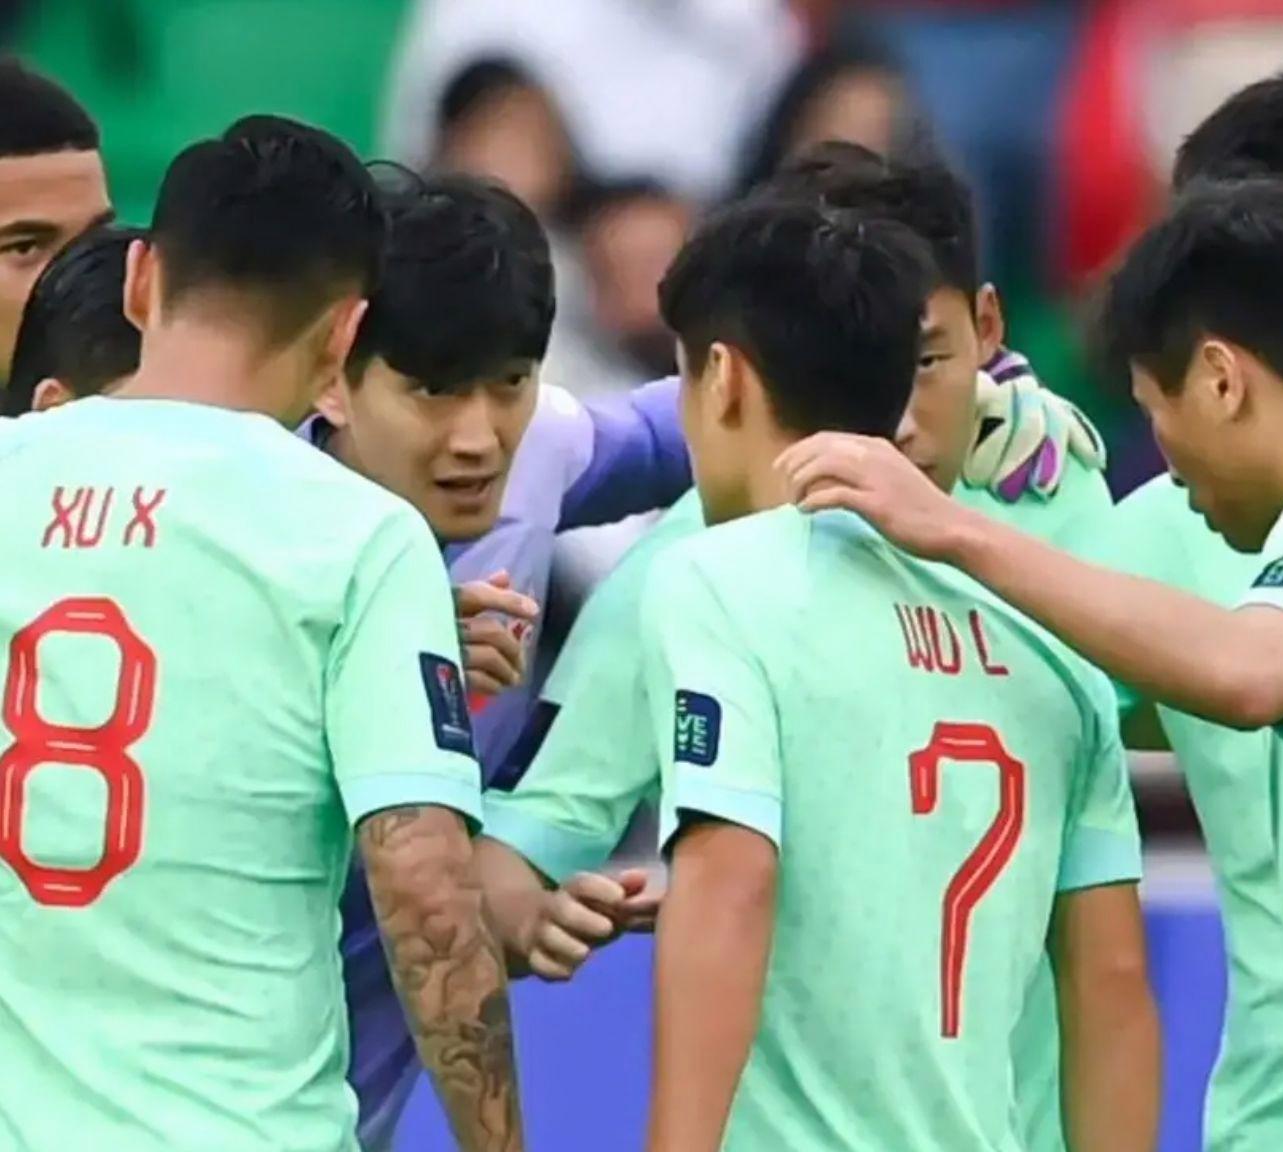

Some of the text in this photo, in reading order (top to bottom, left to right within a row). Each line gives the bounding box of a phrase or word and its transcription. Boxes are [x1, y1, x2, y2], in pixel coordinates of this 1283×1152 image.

[41, 486, 167, 548] XU X
[893, 601, 1010, 675] WU L
[0, 596, 158, 908] 8
[907, 721, 1026, 1039] 7
